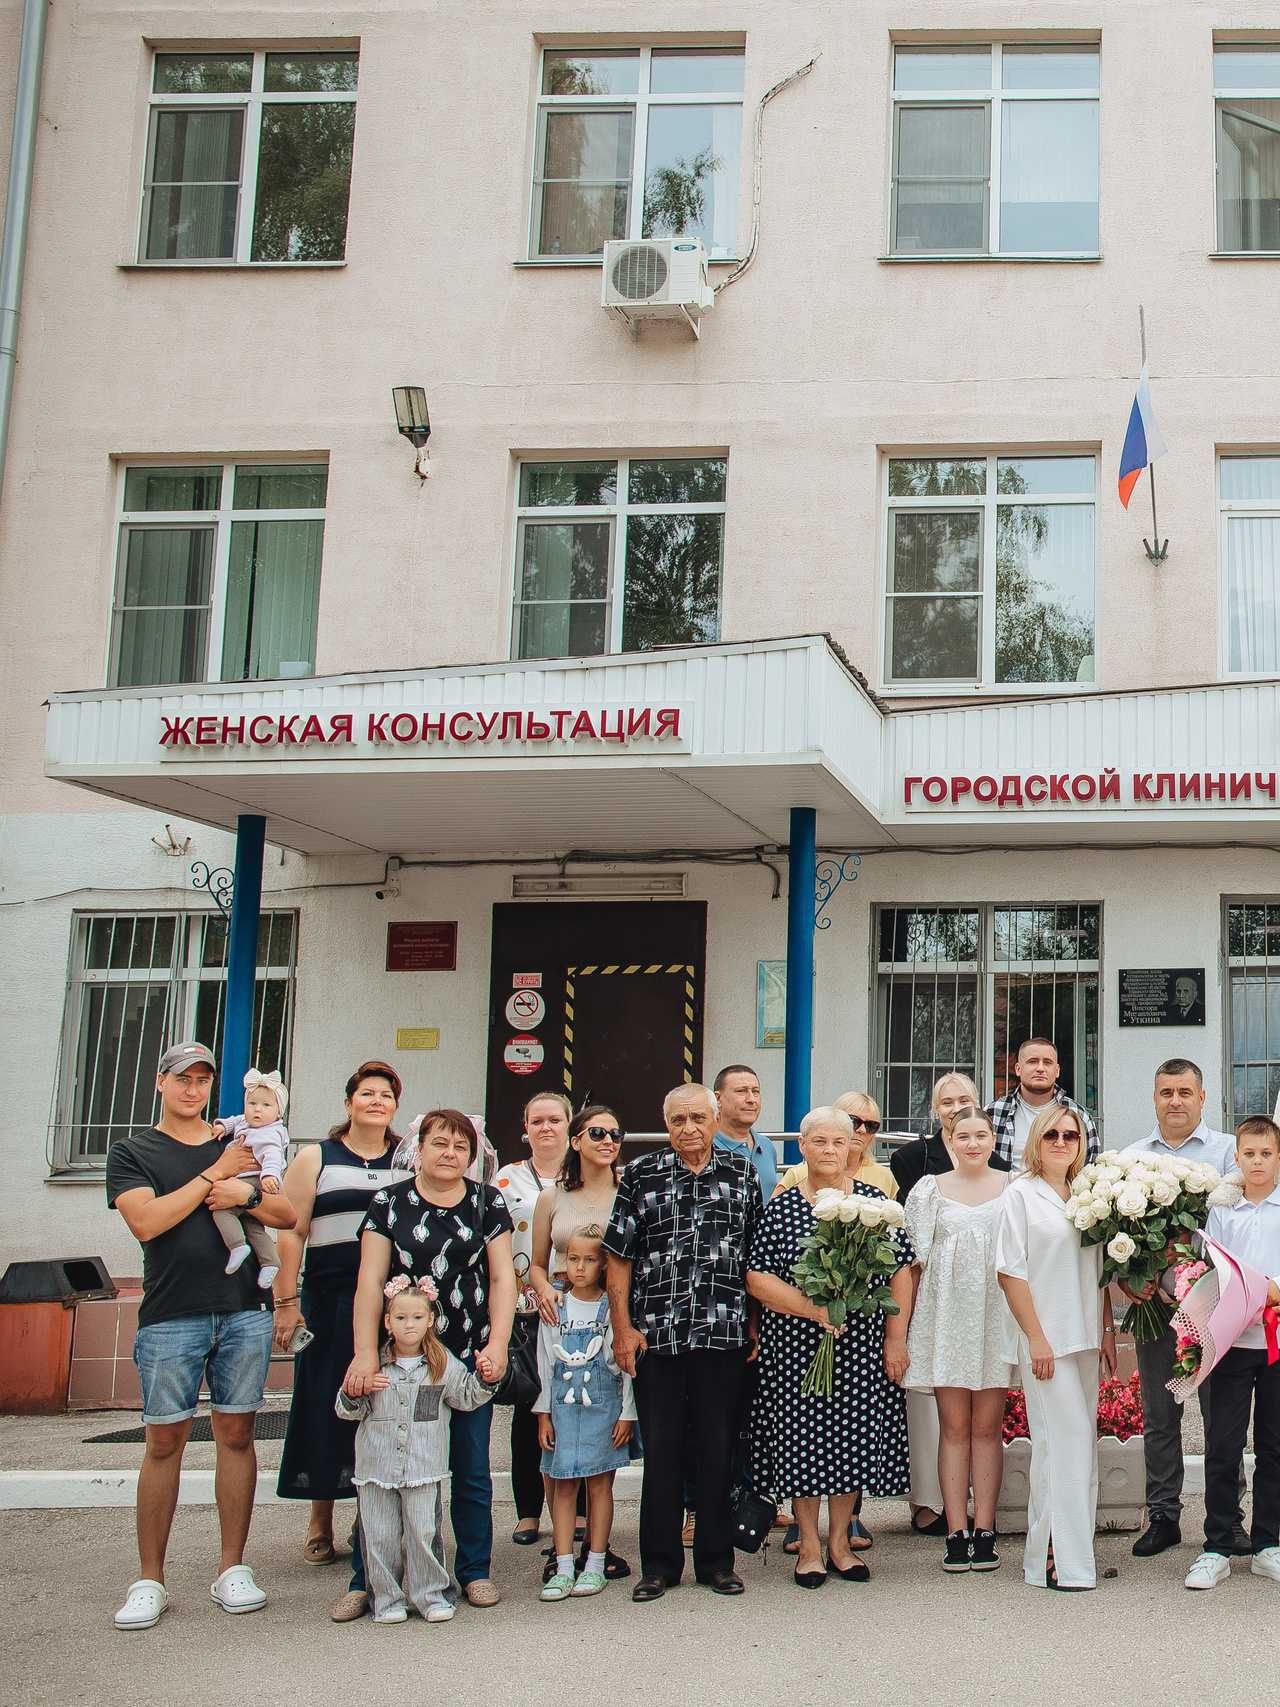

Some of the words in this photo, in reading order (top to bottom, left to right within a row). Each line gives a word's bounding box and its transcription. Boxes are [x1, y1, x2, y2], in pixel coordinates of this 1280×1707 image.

[158, 714, 354, 746] ЖЕНСКАЯ
[367, 708, 681, 744] КОНСУЛЬТАЦИЯ
[904, 767, 1121, 808] ГОРОДСКОЙ
